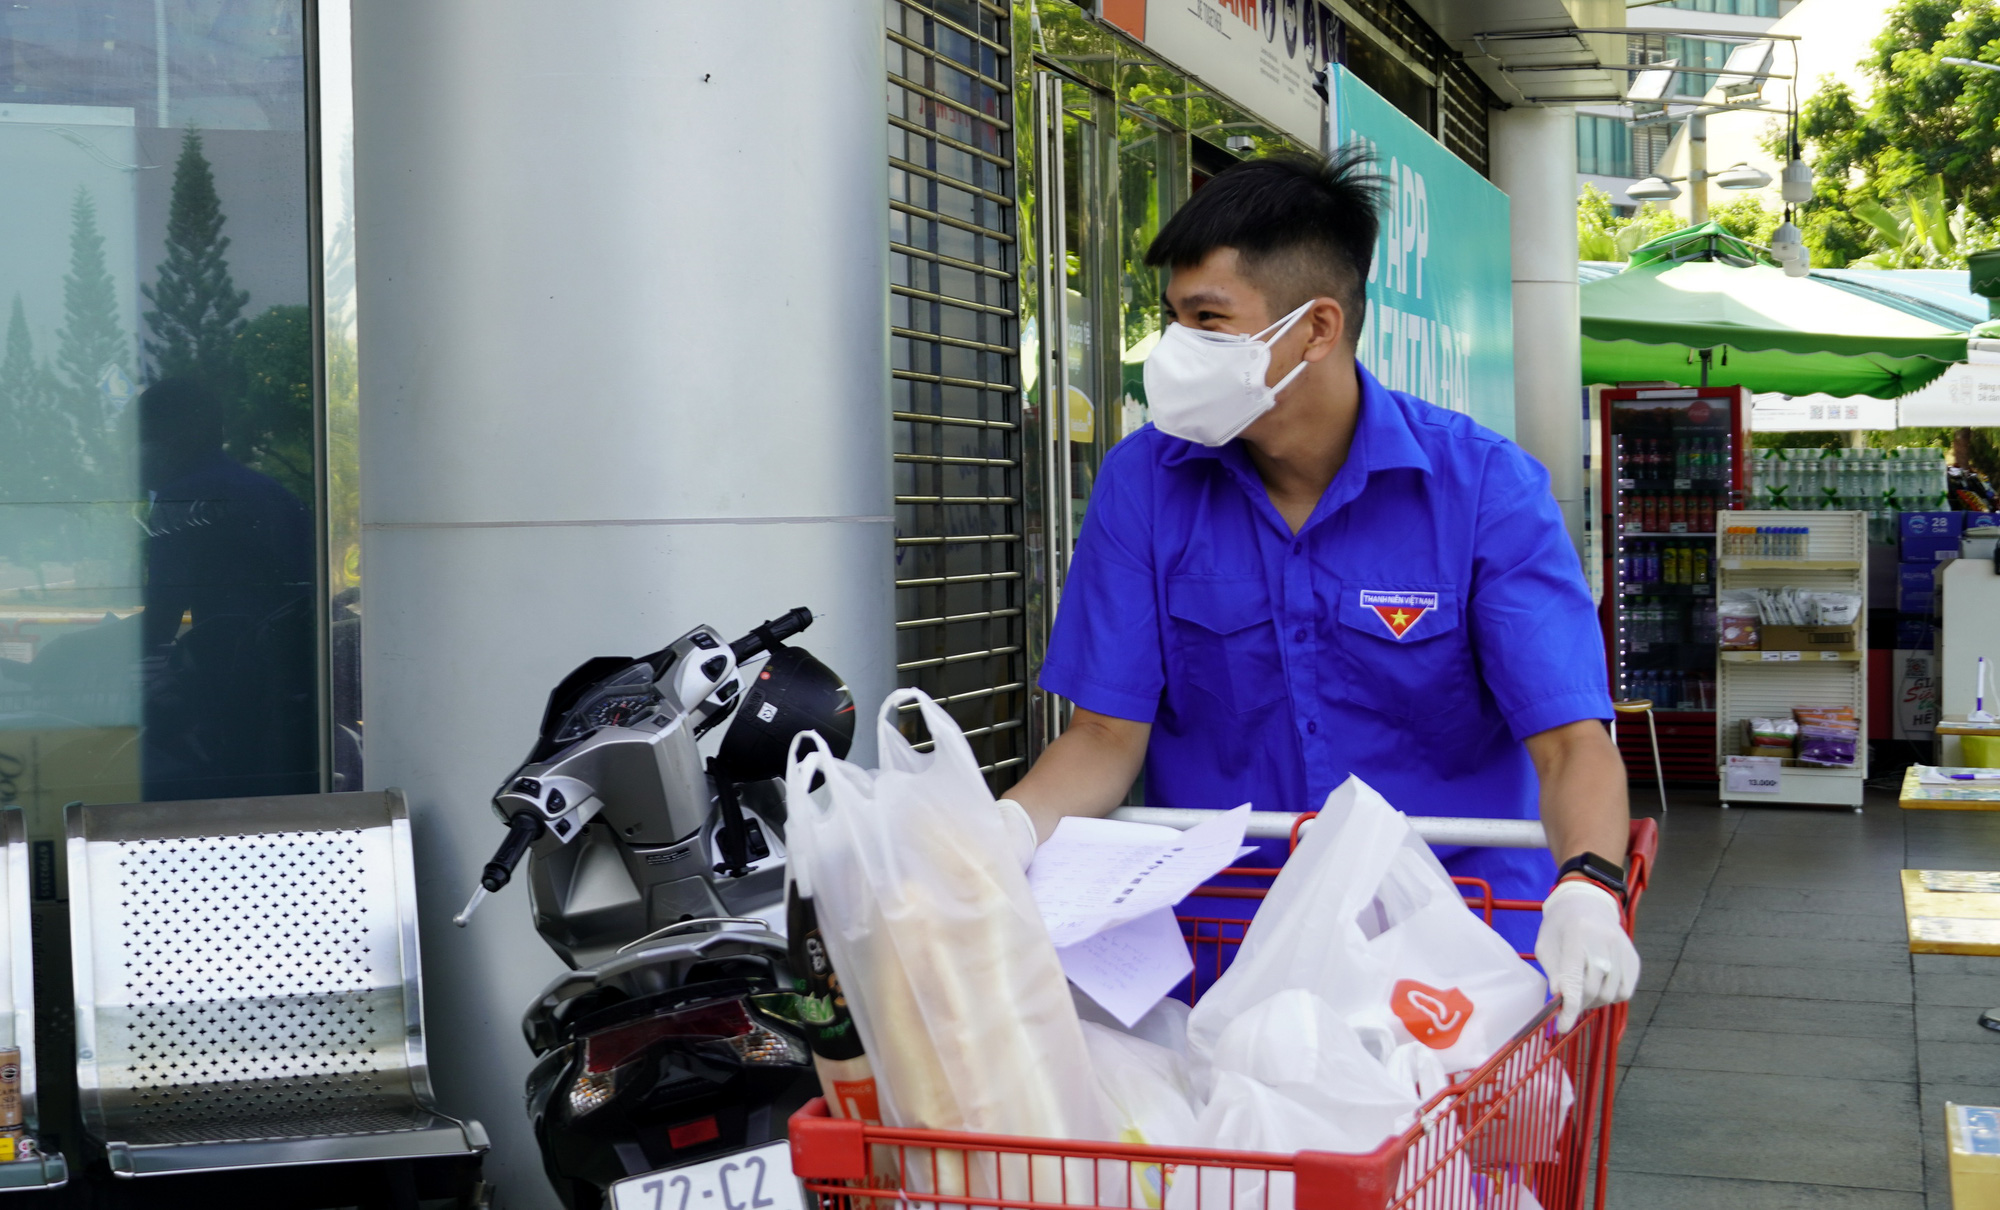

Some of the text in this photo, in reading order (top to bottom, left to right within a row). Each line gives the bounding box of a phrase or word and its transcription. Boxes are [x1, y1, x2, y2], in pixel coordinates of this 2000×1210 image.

[1385, 156, 1429, 299] APP
[1931, 517, 1948, 527] 28
[1364, 595, 1388, 603] THANH
[1418, 597, 1434, 605] NAM
